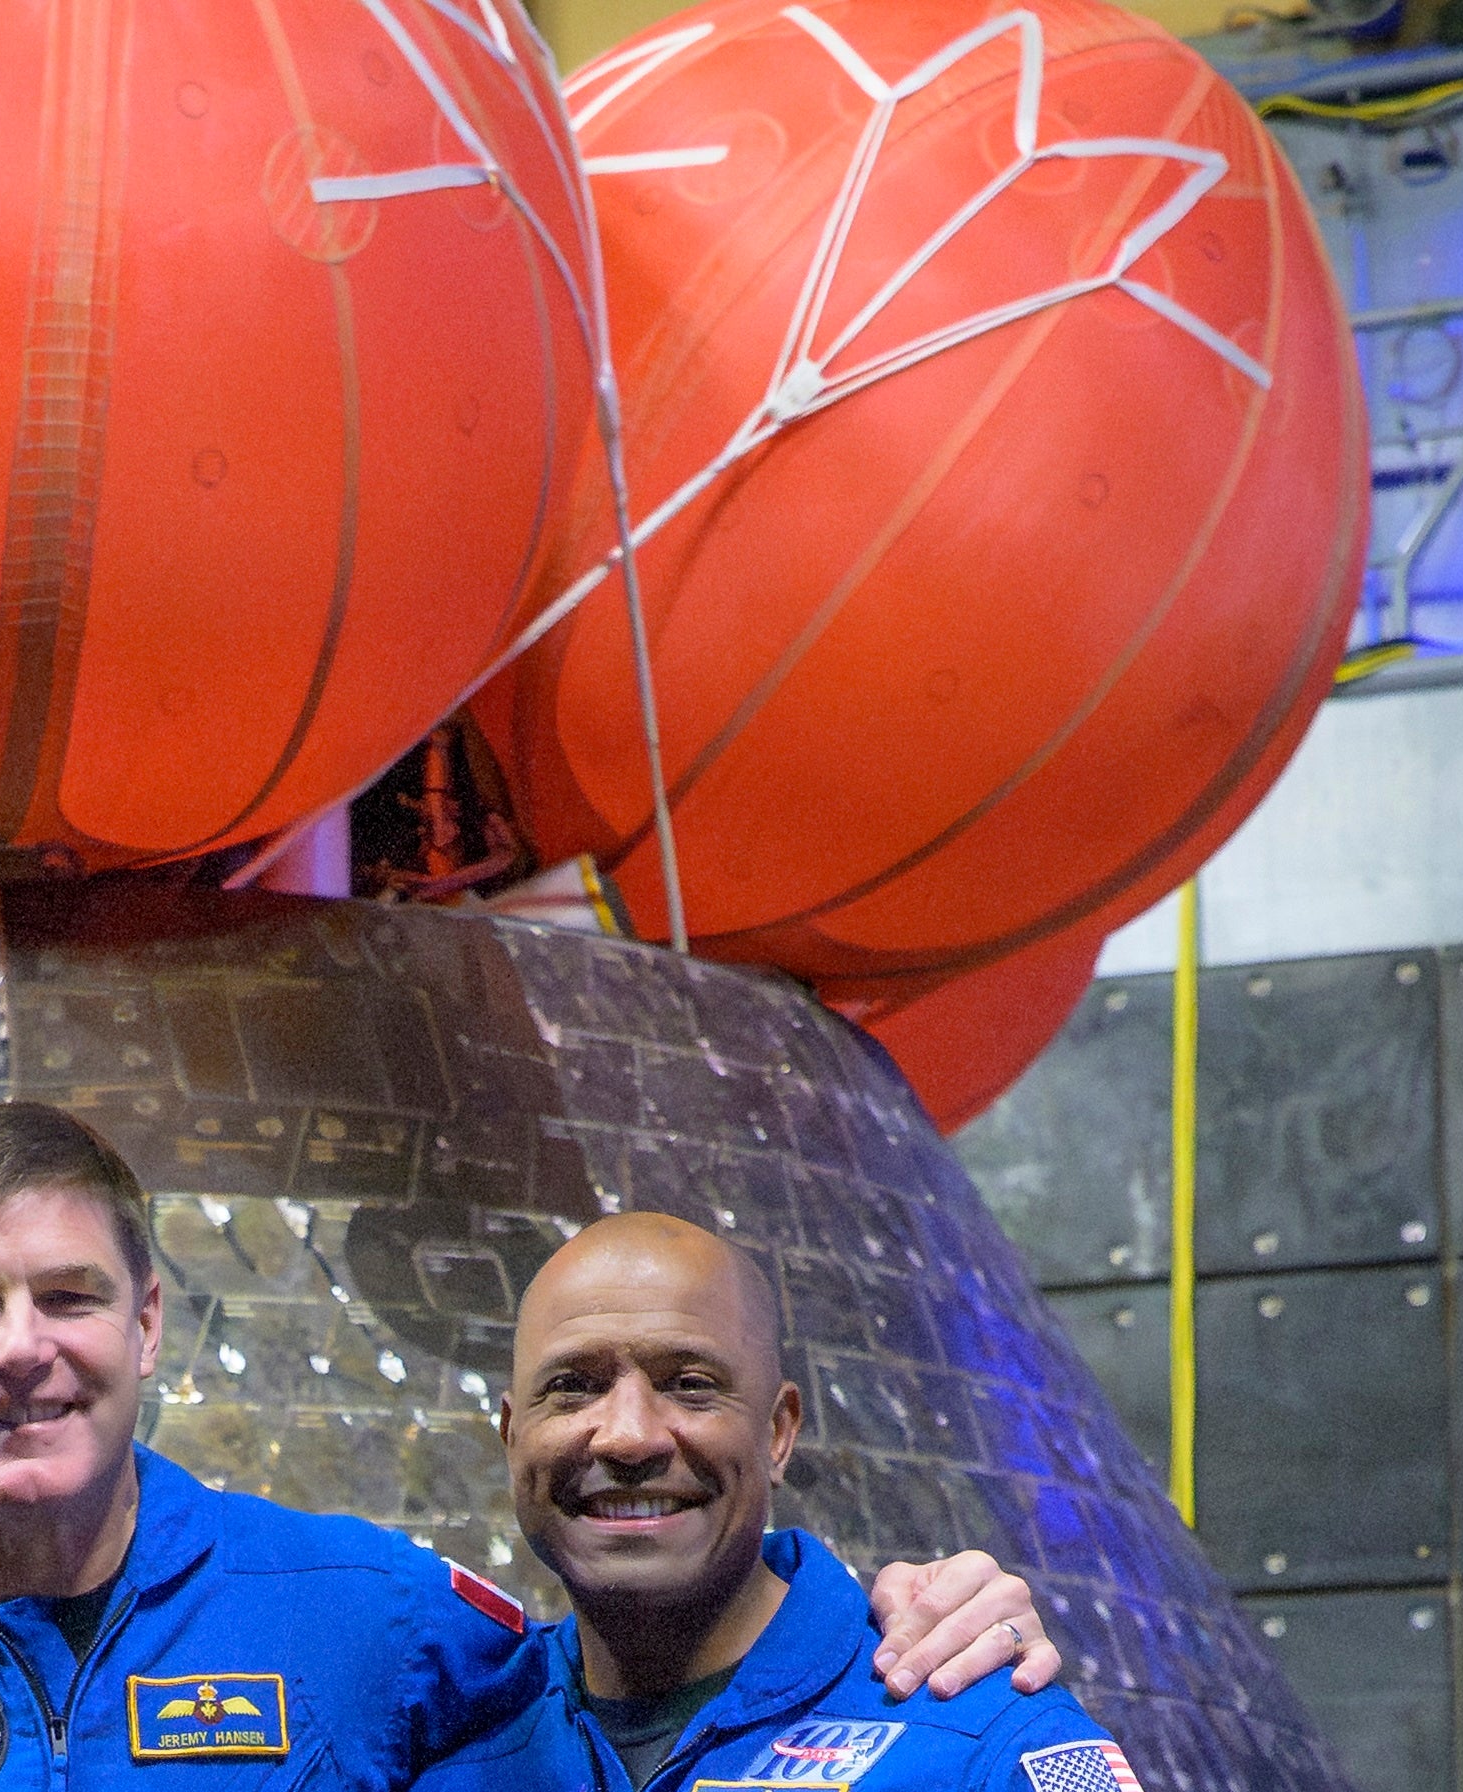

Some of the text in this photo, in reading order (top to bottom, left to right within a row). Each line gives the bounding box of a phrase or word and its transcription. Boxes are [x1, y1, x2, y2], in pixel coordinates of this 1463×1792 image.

[158, 1731, 265, 1748] JEREMY HANSEN
[749, 1724, 890, 1780] 100
